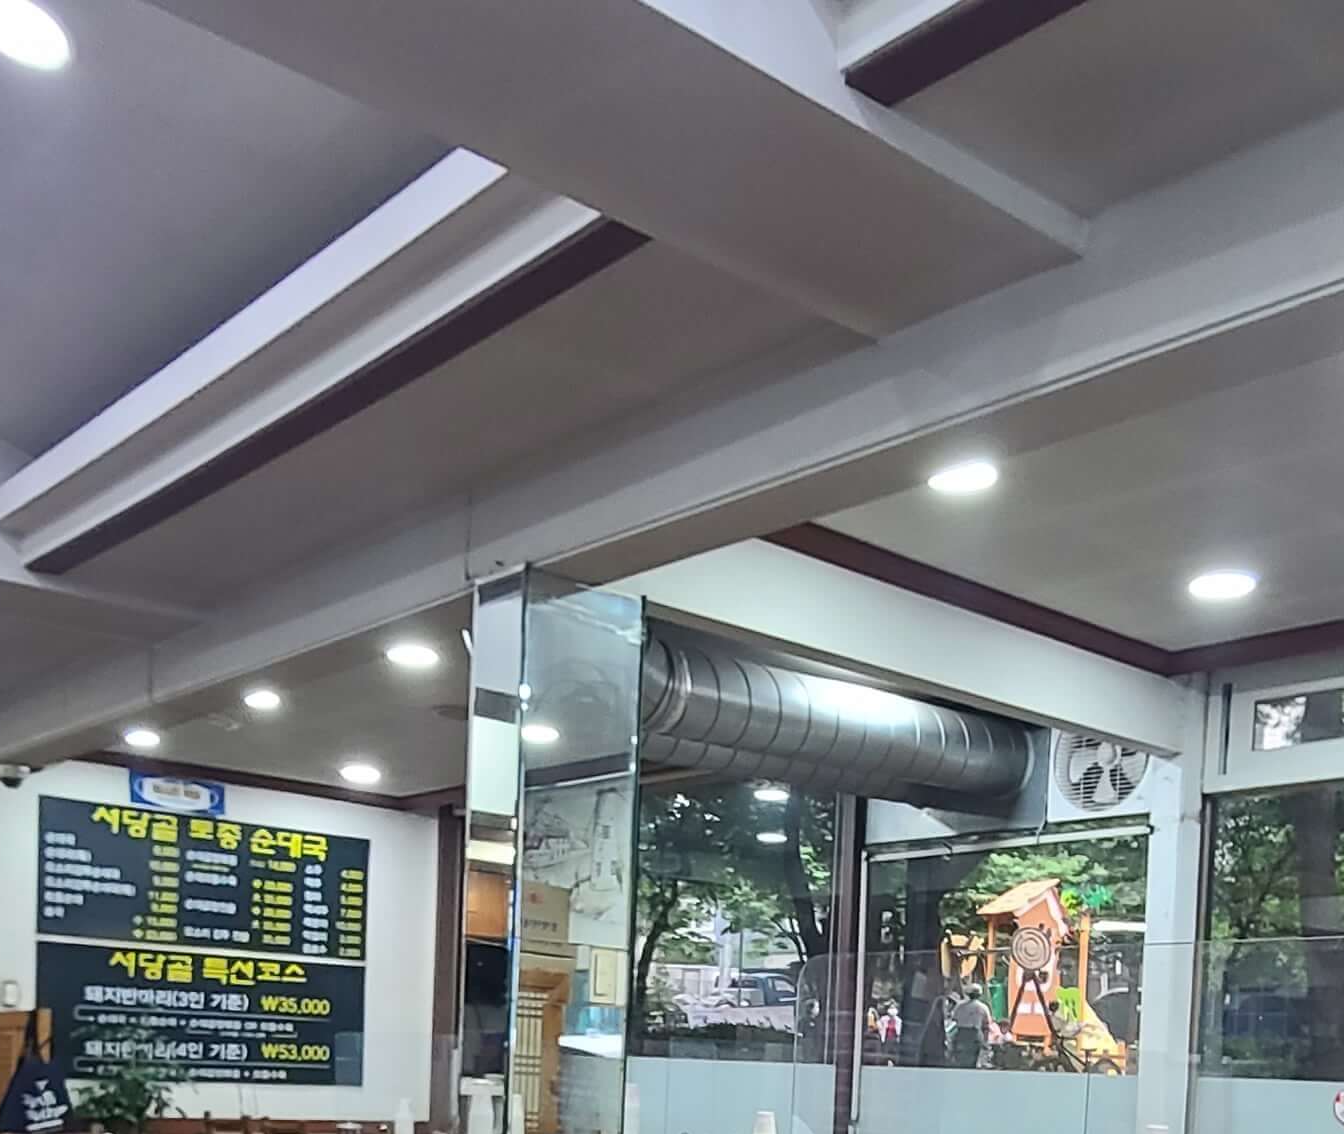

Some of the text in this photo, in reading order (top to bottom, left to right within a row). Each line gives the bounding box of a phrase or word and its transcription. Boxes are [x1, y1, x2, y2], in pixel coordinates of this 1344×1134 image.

[91, 806, 179, 842] 서당골
[249, 828, 329, 862] 순대국
[109, 951, 308, 985] 서당골 특선코스
[210, 993, 249, 1012] 기준)
[208, 1043, 248, 1061] 기준)
